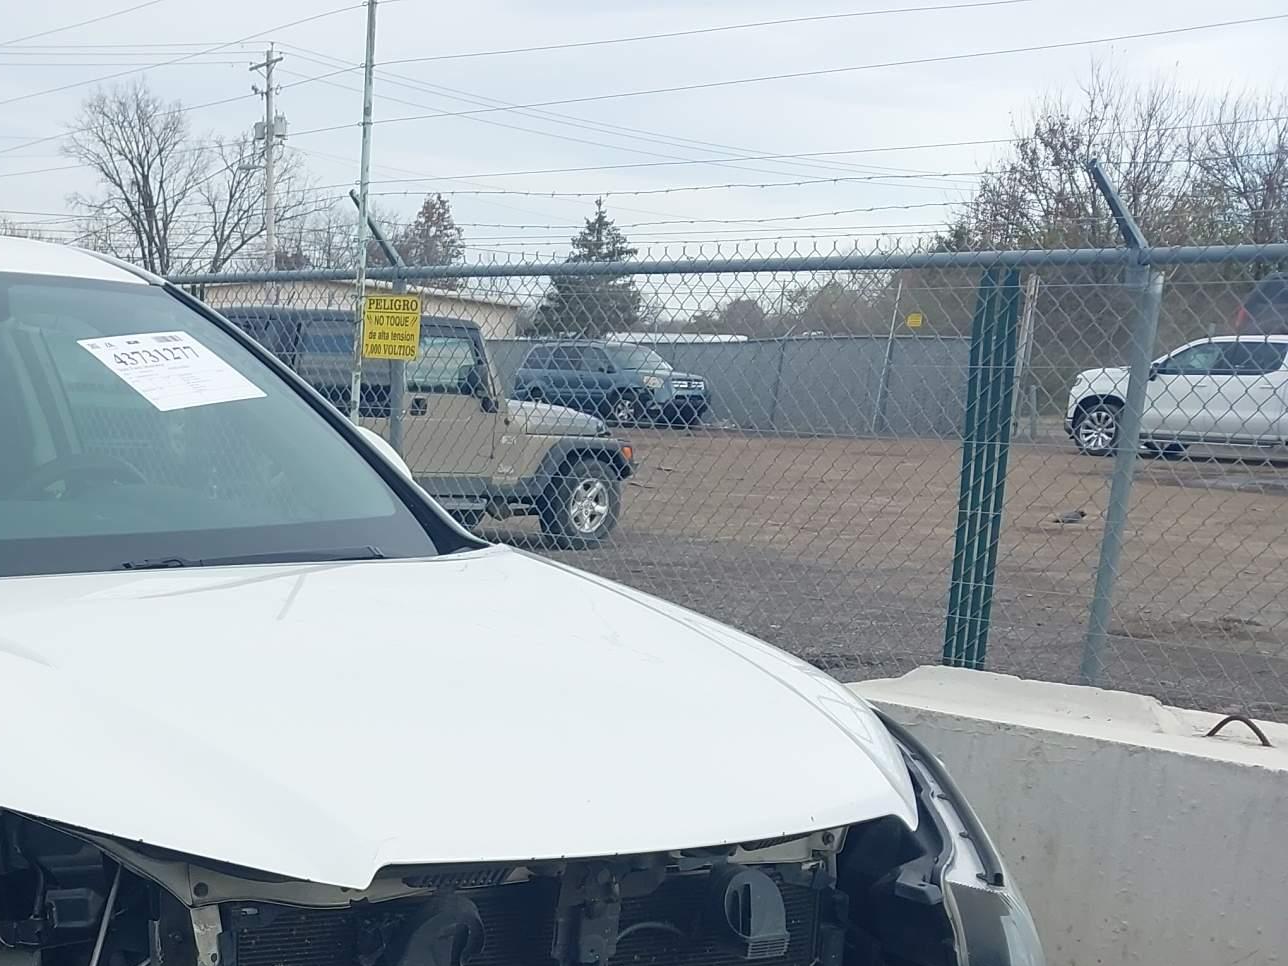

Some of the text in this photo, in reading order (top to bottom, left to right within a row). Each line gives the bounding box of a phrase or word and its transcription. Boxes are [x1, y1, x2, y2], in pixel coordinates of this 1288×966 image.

[368, 298, 418, 311] PELIGRO
[374, 315, 409, 327] NO TOQUE
[368, 331, 377, 340] de
[378, 331, 390, 341] alta
[113, 346, 199, 365] 43731277
[383, 344, 415, 356] VOLTIOS
